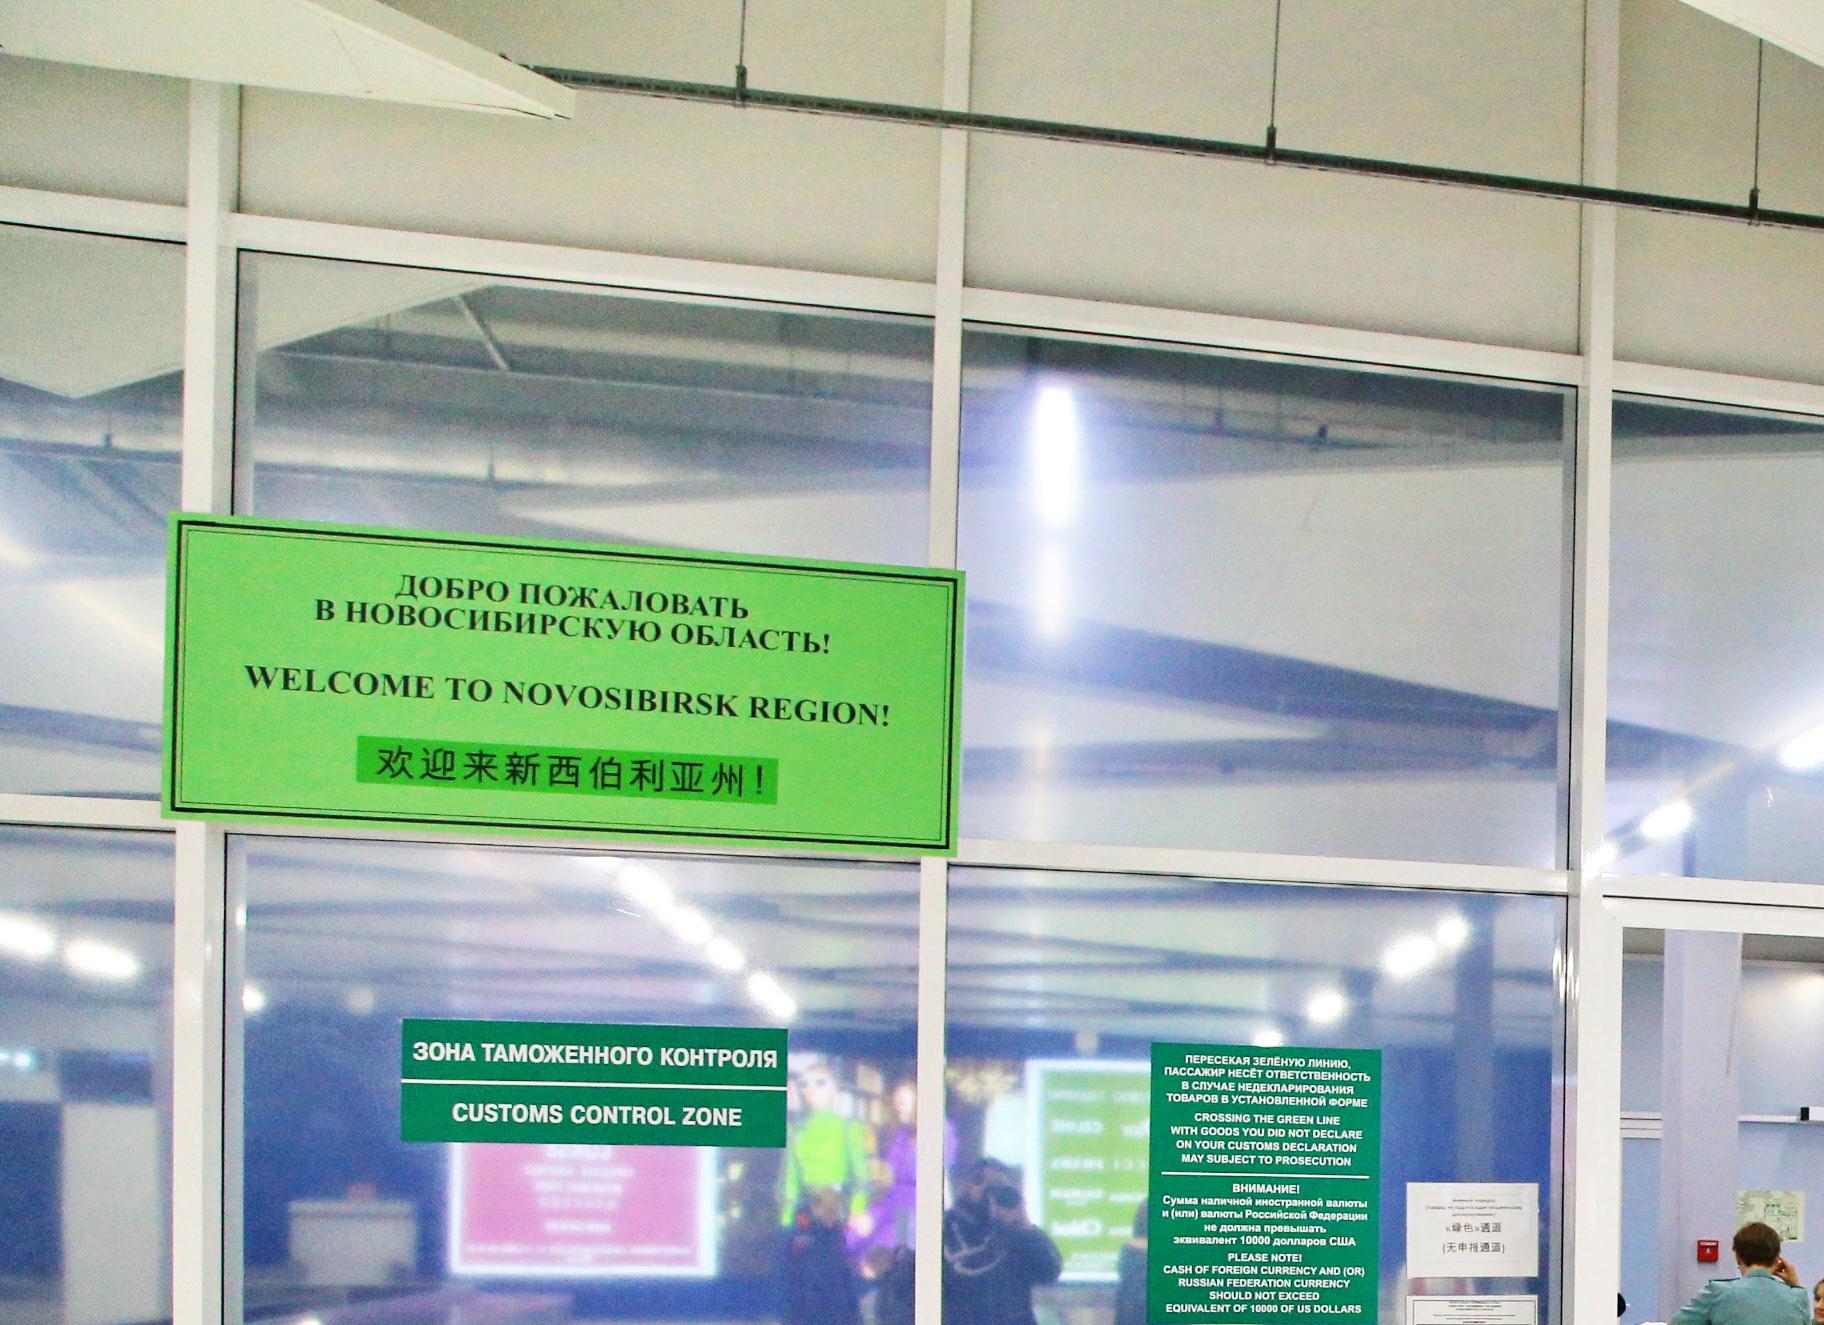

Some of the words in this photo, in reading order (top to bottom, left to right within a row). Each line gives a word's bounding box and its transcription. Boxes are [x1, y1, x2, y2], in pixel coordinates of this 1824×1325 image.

[395, 575, 508, 602] ДОБРО
[520, 583, 748, 618] ПОЖАЛОВАТЬ
[316, 599, 334, 620] В
[347, 601, 661, 642] НОВОСИБИРСКУЮ
[671, 624, 830, 654] ОБЛАСТЬ!
[244, 666, 433, 698] WELCOME
[446, 678, 492, 702] TO
[504, 682, 738, 716] NOVOSIBIRSK
[750, 697, 888, 726] REGION!
[413, 1042, 476, 1061] ЗОНА
[481, 1044, 653, 1065] ТАМОЖЕННОГО
[661, 1048, 777, 1068] КОНТРОЛЯ
[1186, 1055, 1250, 1065] ПЕРЕСЕКАЯ
[1253, 1056, 1305, 1067] ЗЕЛЁНУЮ
[1164, 1067, 1225, 1076] ПАССАЖИР
[1228, 1068, 1263, 1078] НЕСЁТ
[1266, 1070, 1370, 1081] ОТВЕТСТВЕННОСТЬ
[1182, 1081, 1189, 1090] В
[1192, 1082, 1235, 1091] СЛУЧАЕ
[1238, 1083, 1354, 1094] НЕДЕКЛАРИРОВАНИЯ
[1166, 1093, 1218, 1103] ТОВАРОВ
[1222, 1095, 1229, 1103] В
[1232, 1095, 1326, 1106] УСТАНОВЛЕННОЙ
[1329, 1098, 1368, 1107] ФОРМЕ
[453, 1103, 562, 1123] CUSTOMS
[570, 1105, 676, 1125] CONTROL
[682, 1108, 742, 1126] ZONE
[1194, 1113, 1250, 1122] CROSSING
[1253, 1114, 1274, 1123] THE
[1277, 1115, 1314, 1124] GREEN
[1317, 1116, 1340, 1125] LINE
[1171, 1126, 1197, 1135] WITH
[1201, 1127, 1239, 1136] GOODS
[1242, 1128, 1264, 1136] YOU
[1268, 1129, 1286, 1137] DID
[1288, 1129, 1310, 1138] NOT
[1313, 1130, 1362, 1139] DECLARE
[1176, 1140, 1192, 1148] ON
[1194, 1141, 1225, 1149] YOUR
[1228, 1141, 1279, 1150] CUSTOMS
[1283, 1142, 1356, 1152] DECLARATION
[1182, 1154, 1204, 1162] MAY
[1207, 1155, 1256, 1164] SUBJECT
[1258, 1156, 1272, 1164] TO
[1276, 1156, 1351, 1166] PROSECUTION
[1233, 1184, 1299, 1194] ВНИМАНИЕ!
[1163, 1195, 1198, 1206] Сумма
[1201, 1197, 1252, 1205] наличной
[1256, 1198, 1323, 1208] иностранной
[1326, 1200, 1367, 1208] валюты
[1171, 1208, 1198, 1220] (или)
[1246, 1210, 1307, 1219] Российской
[1309, 1211, 1367, 1222] Федерации
[1264, 1225, 1326, 1234] превышать
[1240, 1236, 1270, 1244] 10000
[1273, 1238, 1326, 1247] долларов
[1330, 1237, 1356, 1246] США
[1228, 1253, 1268, 1262] PLEASE
[1271, 1254, 1302, 1262] NOTE!
[1164, 1265, 1192, 1274] CASH
[1195, 1266, 1209, 1274] OF
[1212, 1266, 1258, 1274] FOREIGN
[1261, 1266, 1317, 1275] CURRENCY
[1319, 1267, 1340, 1275] AND
[1343, 1267, 1364, 1277] (OR)
[1179, 1278, 1224, 1286] RUSSIAN
[1227, 1279, 1291, 1287] FEDERATION
[1294, 1280, 1350, 1288] CURRENCY
[1210, 1291, 1252, 1300] SHOULD
[1255, 1292, 1276, 1300] NOT
[1279, 1292, 1319, 1300] EXCEED
[1166, 1304, 1231, 1312] EQUIVALENT
[1233, 1304, 1247, 1312] OF
[1250, 1304, 1278, 1312] 10000
[1298, 1305, 1311, 1313] US
[1314, 1305, 1361, 1313] DOLLARS
